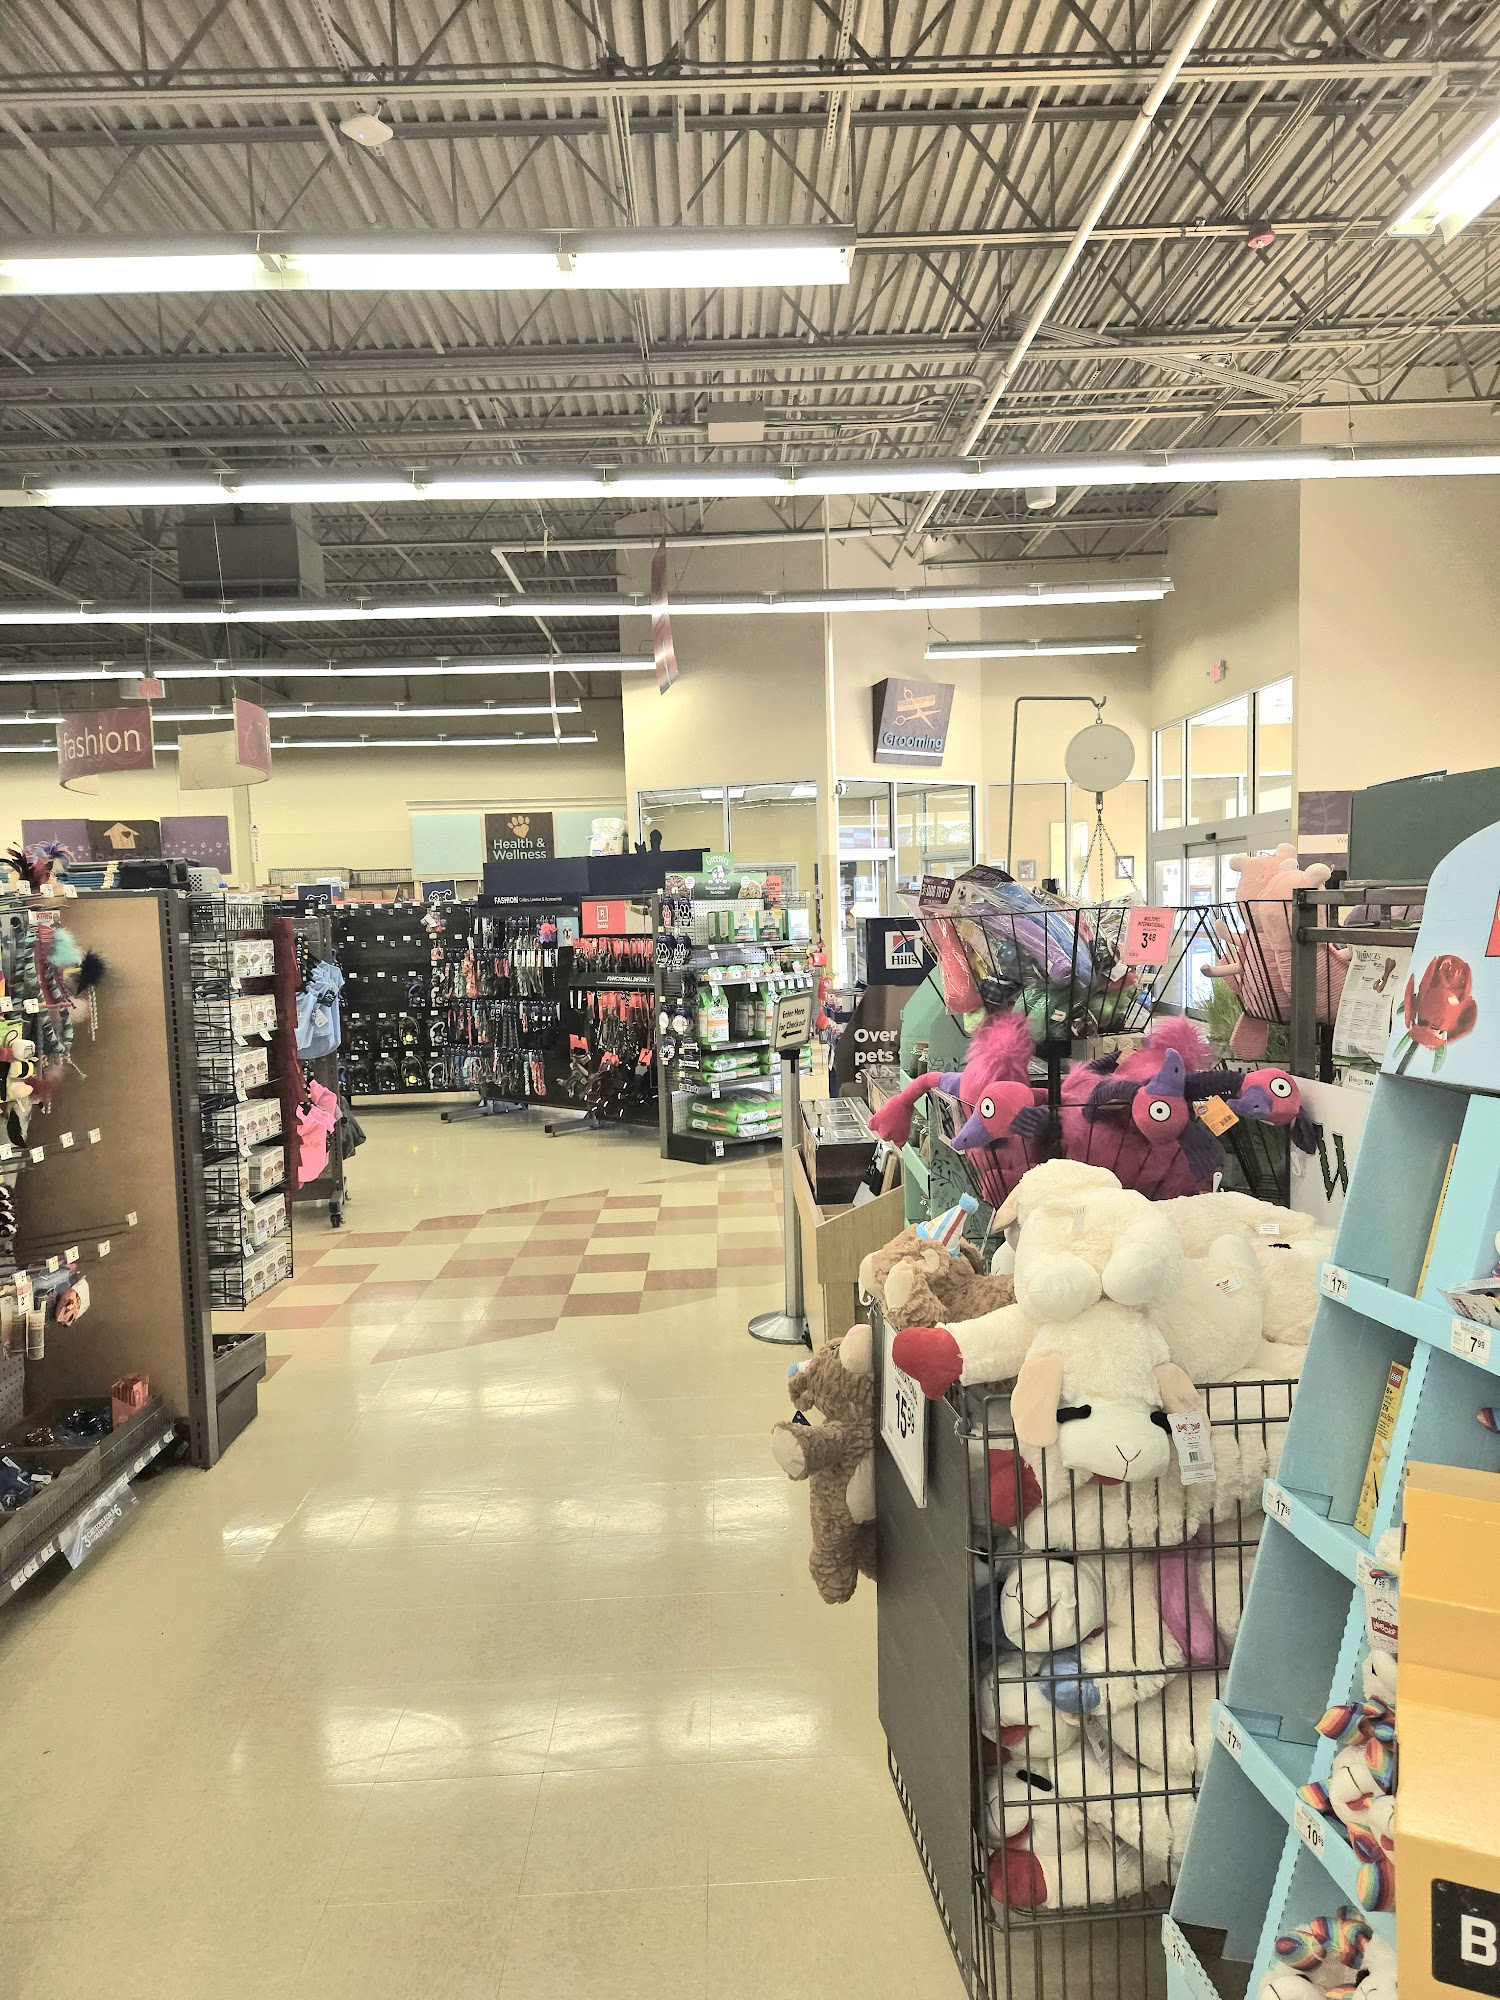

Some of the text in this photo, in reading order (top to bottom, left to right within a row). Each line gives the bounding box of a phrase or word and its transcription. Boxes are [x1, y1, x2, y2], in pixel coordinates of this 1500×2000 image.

[63, 726, 141, 764] fashion
[883, 731, 943, 752] Grooming
[493, 838, 546, 850] Health &
[493, 850, 547, 860] Wellness
[494, 896, 519, 905] FASHION
[36, 912, 53, 921] KONG
[892, 954, 918, 966] Hill's
[782, 1008, 805, 1019] Enter Here
[778, 1019, 806, 1032] for Checkout
[854, 1028, 898, 1043] Over
[854, 1048, 895, 1066] pets
[1461, 1914, 1498, 1967] B
